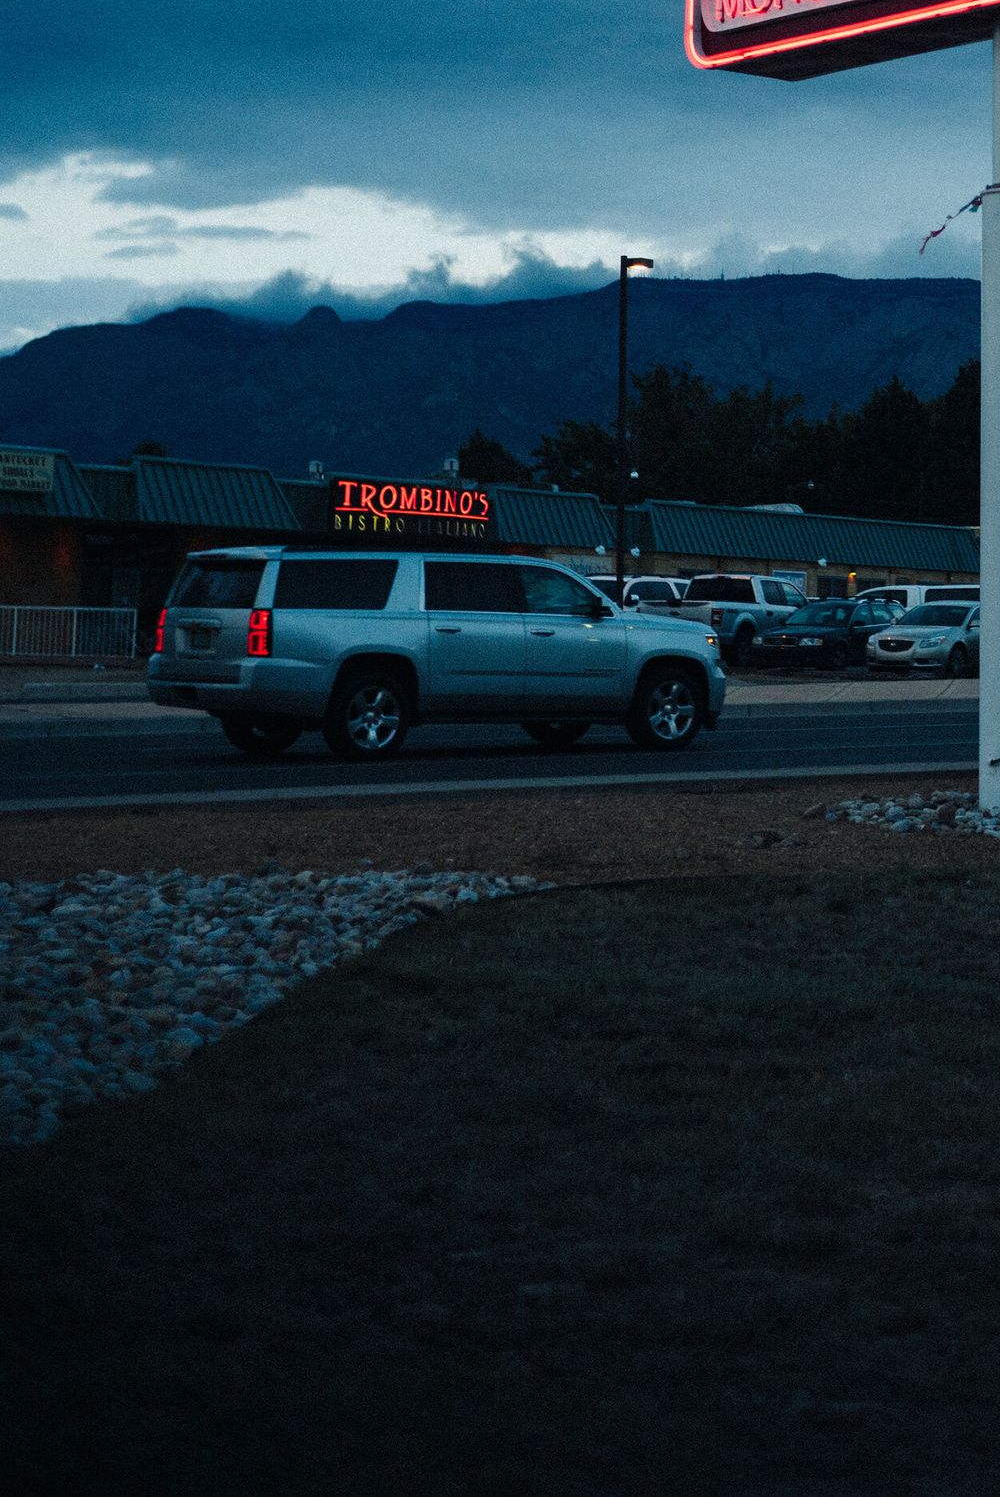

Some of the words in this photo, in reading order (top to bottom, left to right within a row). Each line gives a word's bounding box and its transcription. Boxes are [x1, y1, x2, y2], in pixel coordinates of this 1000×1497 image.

[338, 480, 490, 516] TROMBINO'S
[334, 514, 406, 533] BISTRO
[417, 518, 486, 539] ITALIANO
